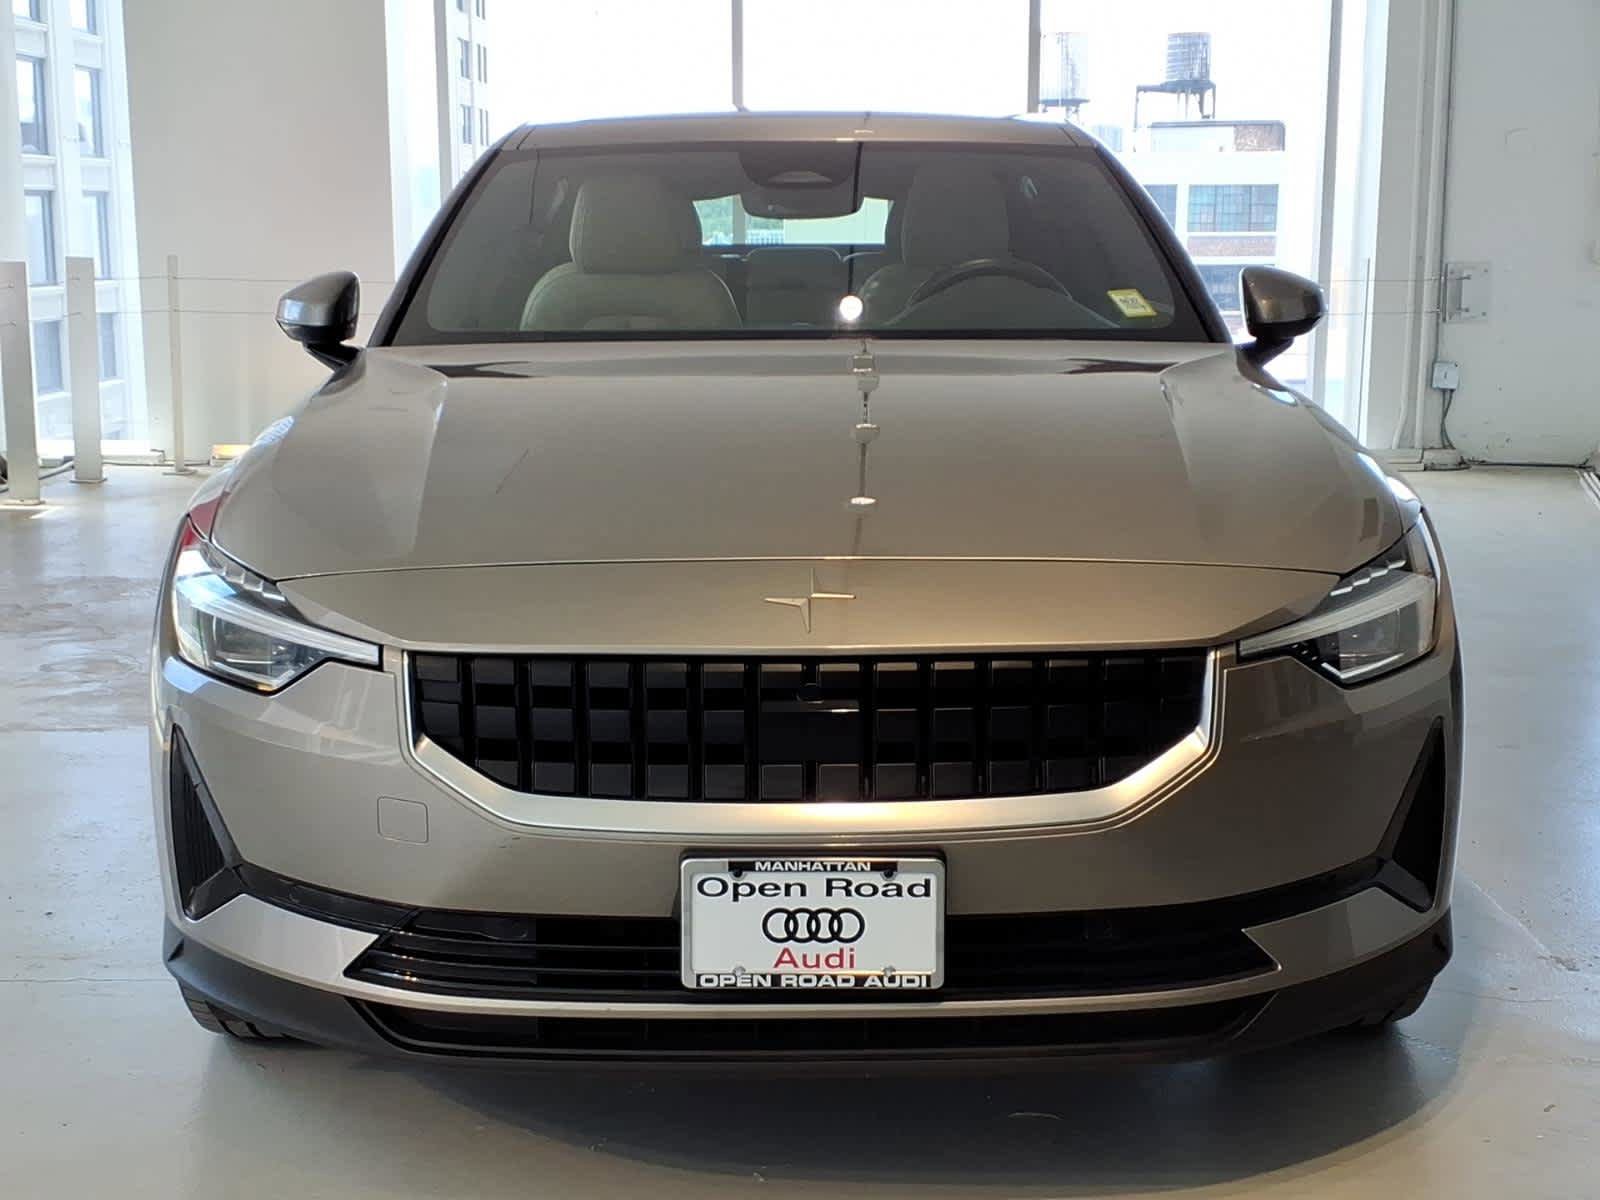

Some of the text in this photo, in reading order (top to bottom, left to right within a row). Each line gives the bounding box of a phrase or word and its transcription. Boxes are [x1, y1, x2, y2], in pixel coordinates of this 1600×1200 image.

[755, 861, 871, 872] MANHATTAN
[697, 877, 931, 902] Open Road
[773, 947, 856, 969] Audi
[700, 974, 928, 988] OPEN ROAD AUDI
